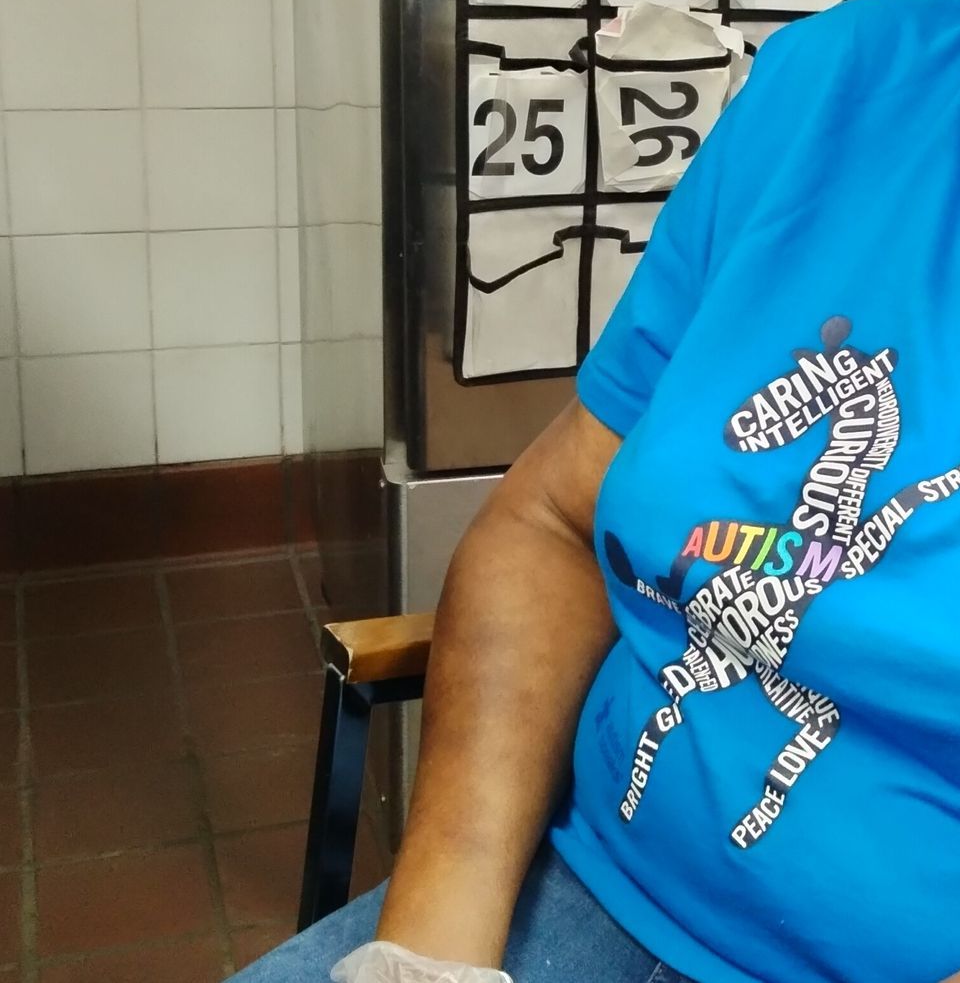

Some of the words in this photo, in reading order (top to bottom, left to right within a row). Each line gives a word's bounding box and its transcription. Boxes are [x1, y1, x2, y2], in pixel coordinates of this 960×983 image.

[472, 98, 565, 176] 25
[619, 80, 700, 168] 26
[730, 349, 859, 439] CARING
[738, 348, 895, 453] INTELLIGENT
[860, 376, 900, 471] NEURODIVERSITY
[792, 393, 876, 537] CURIOUS
[831, 467, 871, 547] DIFFERENT
[681, 520, 844, 583] AUTISM
[840, 497, 914, 580] SPECIAL
[636, 578, 682, 615] BRAVE
[682, 643, 719, 693] TALENTED
[620, 731, 660, 822] BRIGHT
[731, 784, 786, 849] PEACE
[769, 722, 832, 788] LOVE
